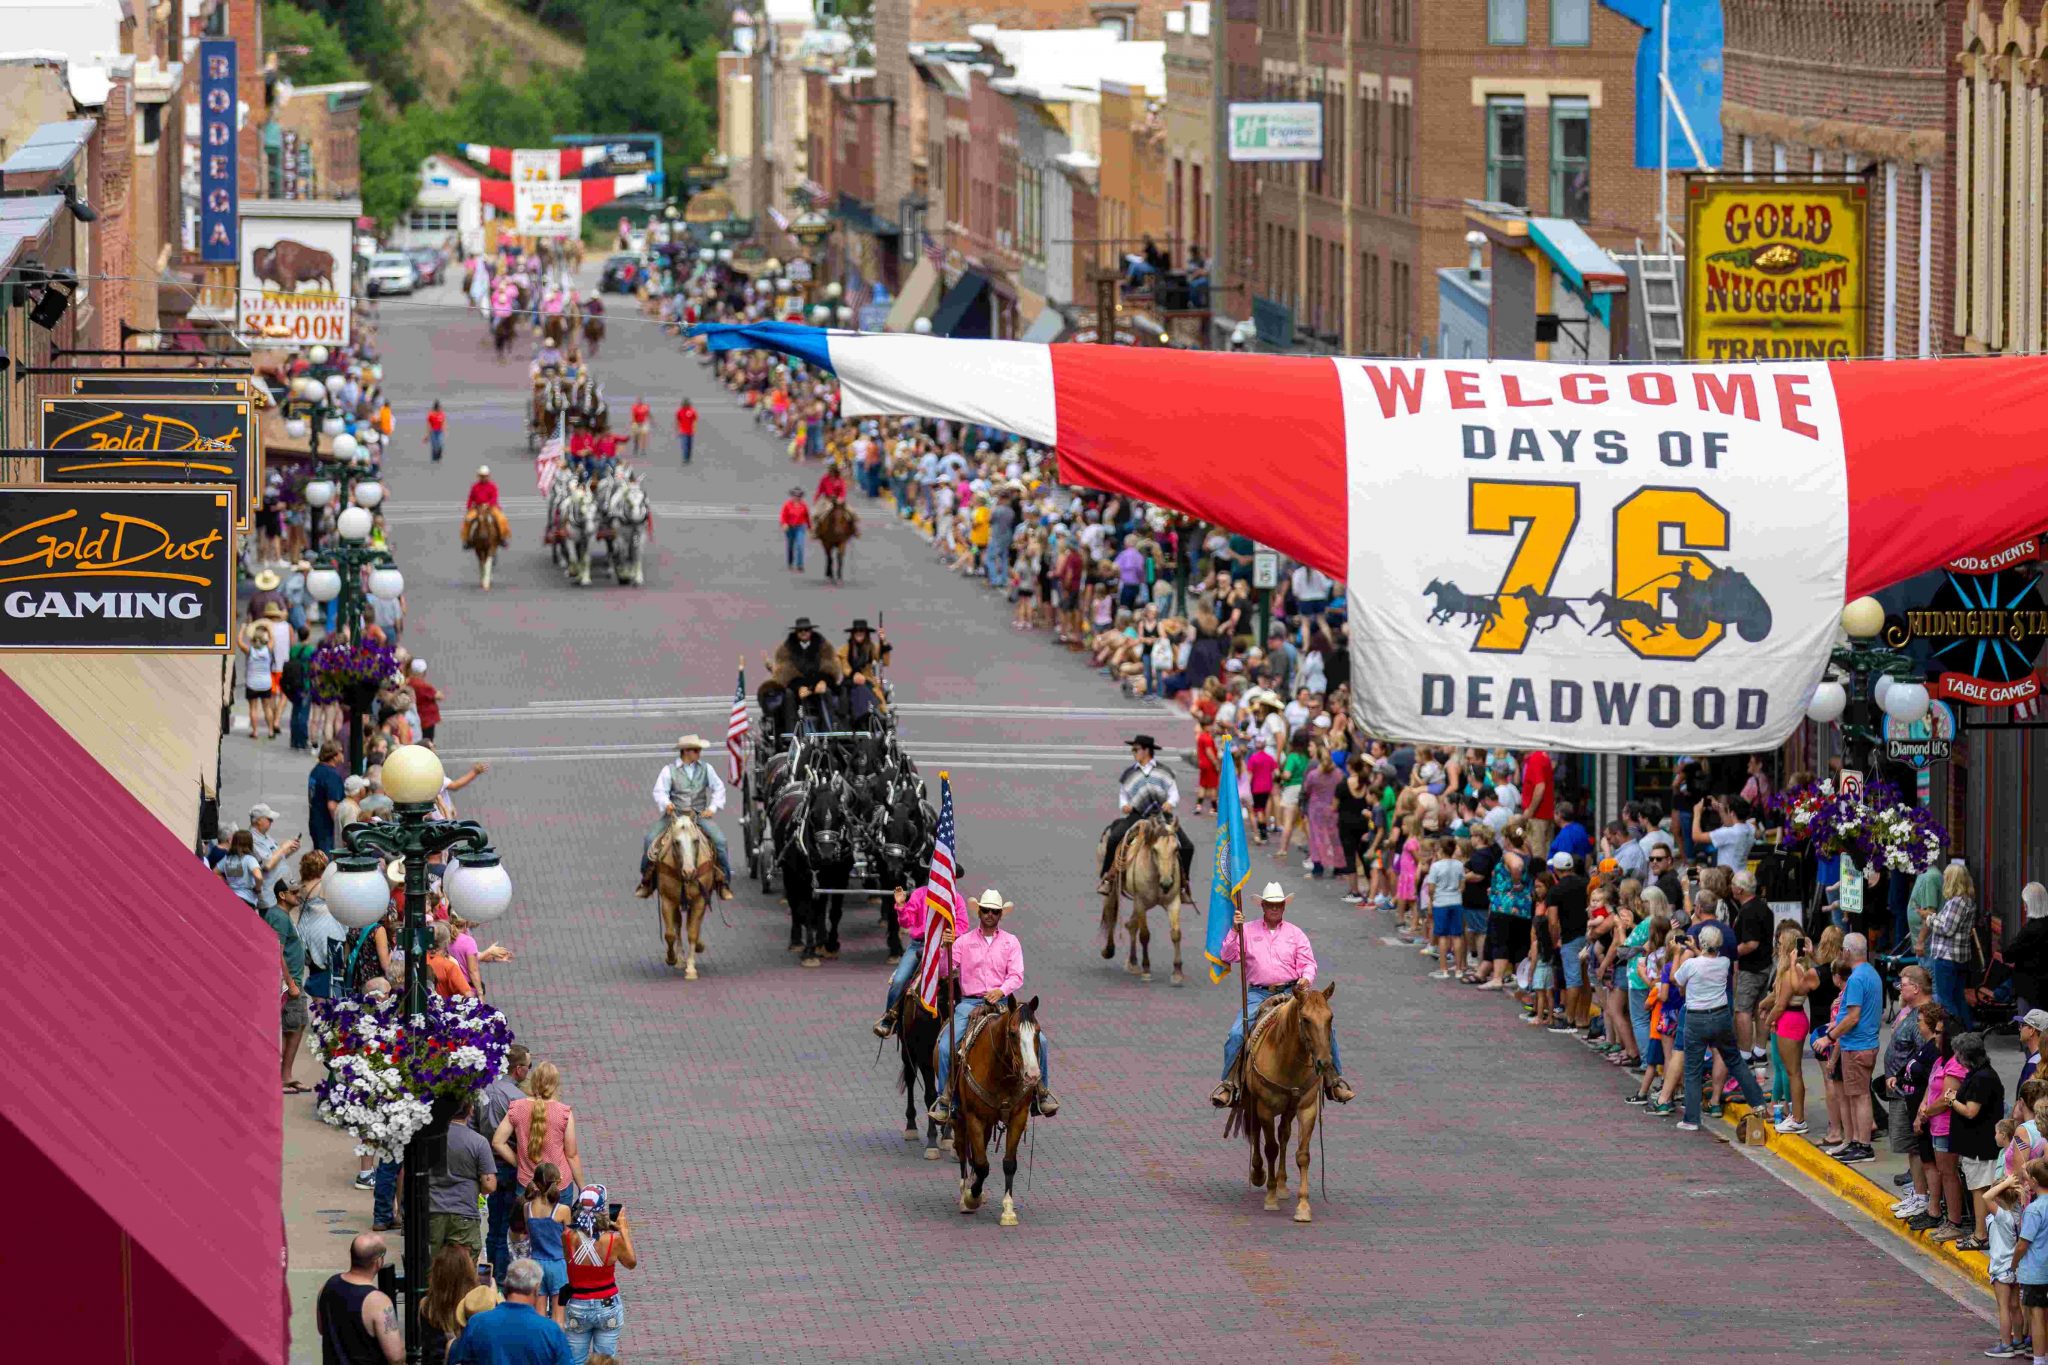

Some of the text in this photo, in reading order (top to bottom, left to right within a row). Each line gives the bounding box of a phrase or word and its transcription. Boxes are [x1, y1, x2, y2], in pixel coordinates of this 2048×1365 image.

[207, 54, 231, 246] BODEGA
[1725, 203, 1832, 244] GOLD
[243, 298, 345, 311] STEAKHOUSE
[1705, 263, 1847, 314] NUGGET
[1707, 337, 1849, 363] TRADING
[1362, 364, 1820, 441] WELCOME
[50, 410, 150, 452] Gold
[1462, 423, 1730, 469] DAYS OF
[0, 508, 223, 569] Gold Dust
[1980, 559, 1989, 570] &
[1990, 540, 2035, 568] EVENTS
[1468, 477, 1731, 662] 76
[4, 590, 203, 620] GAMING
[1887, 610, 2008, 648] MIDNIGHT
[1421, 672, 1769, 731] DEADWOOD
[1946, 678, 2037, 701] TABLE GAMES
[1890, 740, 1930, 758] Diamond
